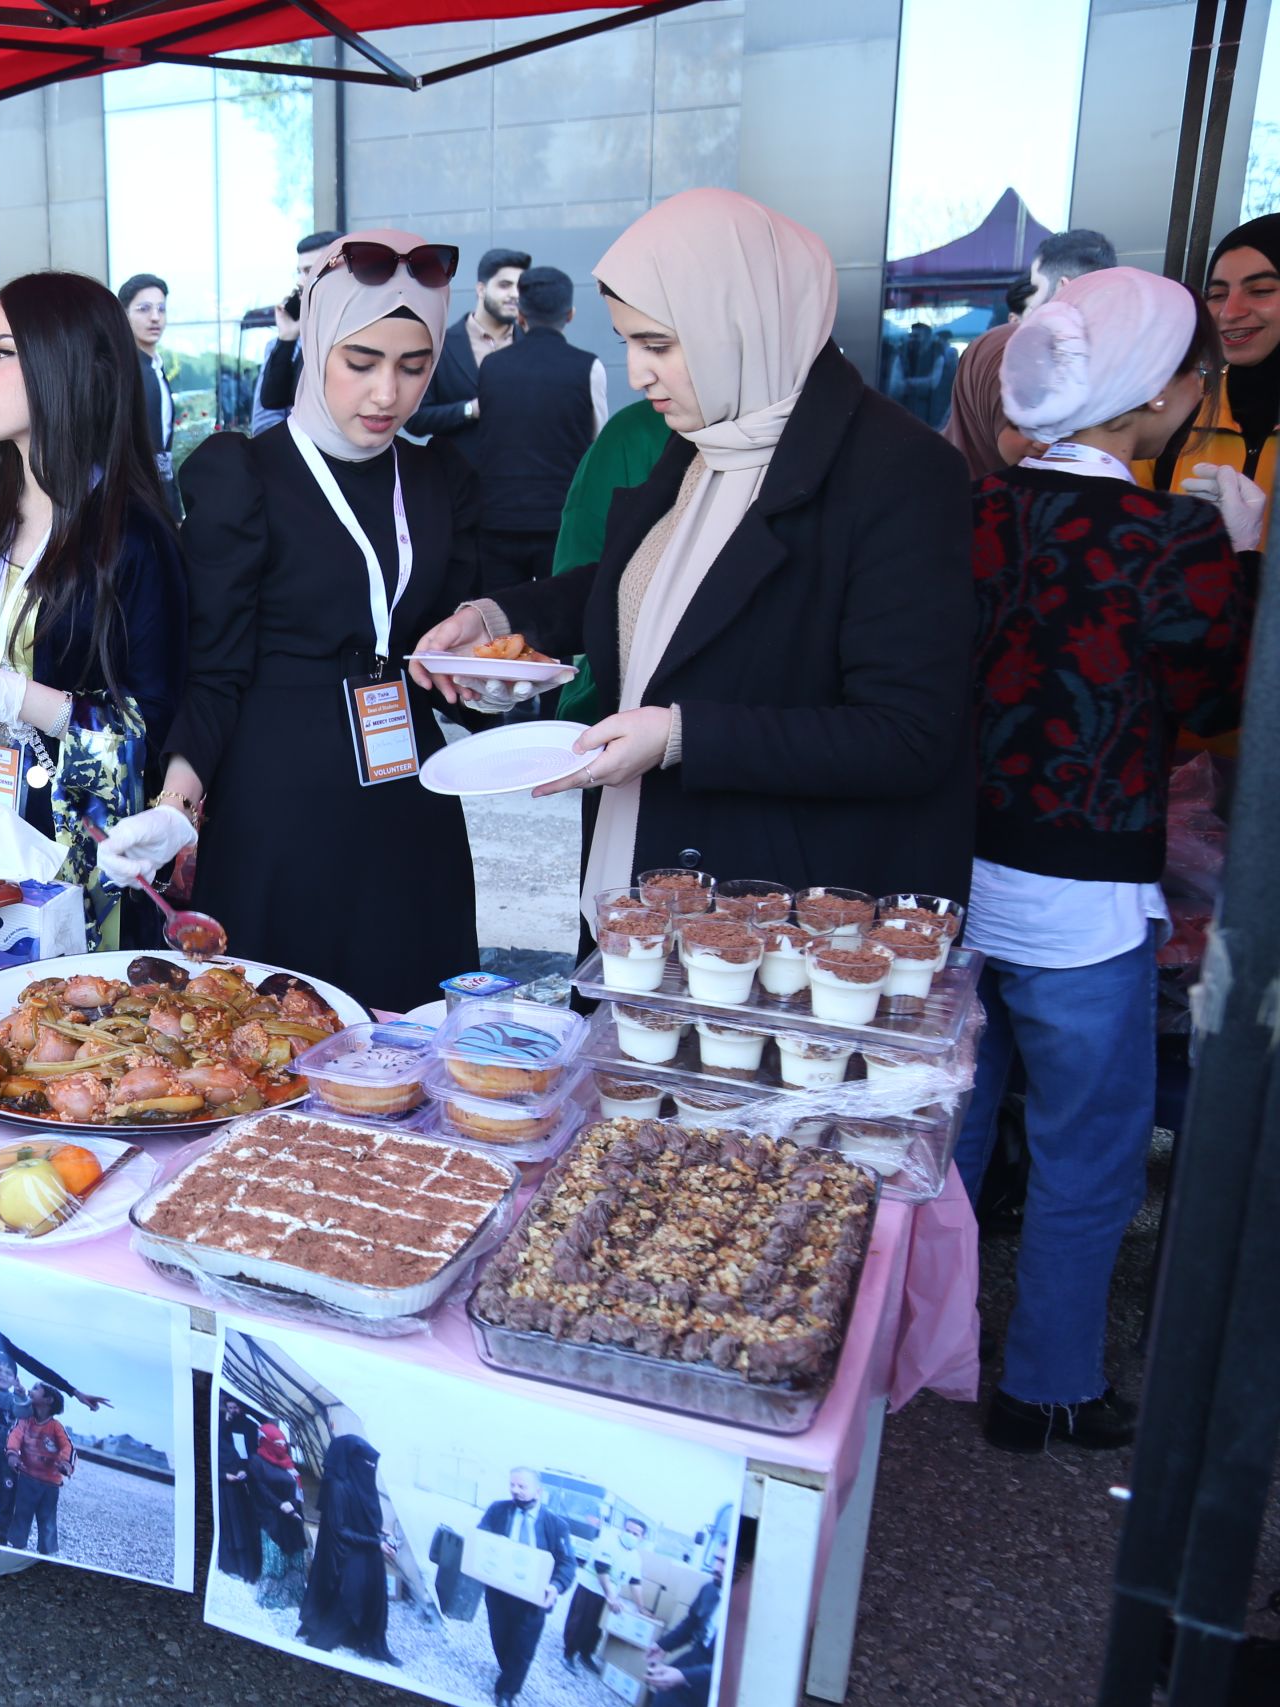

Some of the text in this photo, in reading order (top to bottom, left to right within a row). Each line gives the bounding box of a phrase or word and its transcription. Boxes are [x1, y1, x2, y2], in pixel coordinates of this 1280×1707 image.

[372, 715, 406, 726] MERCY CORNER
[373, 763, 412, 776] VOLUNTEER
